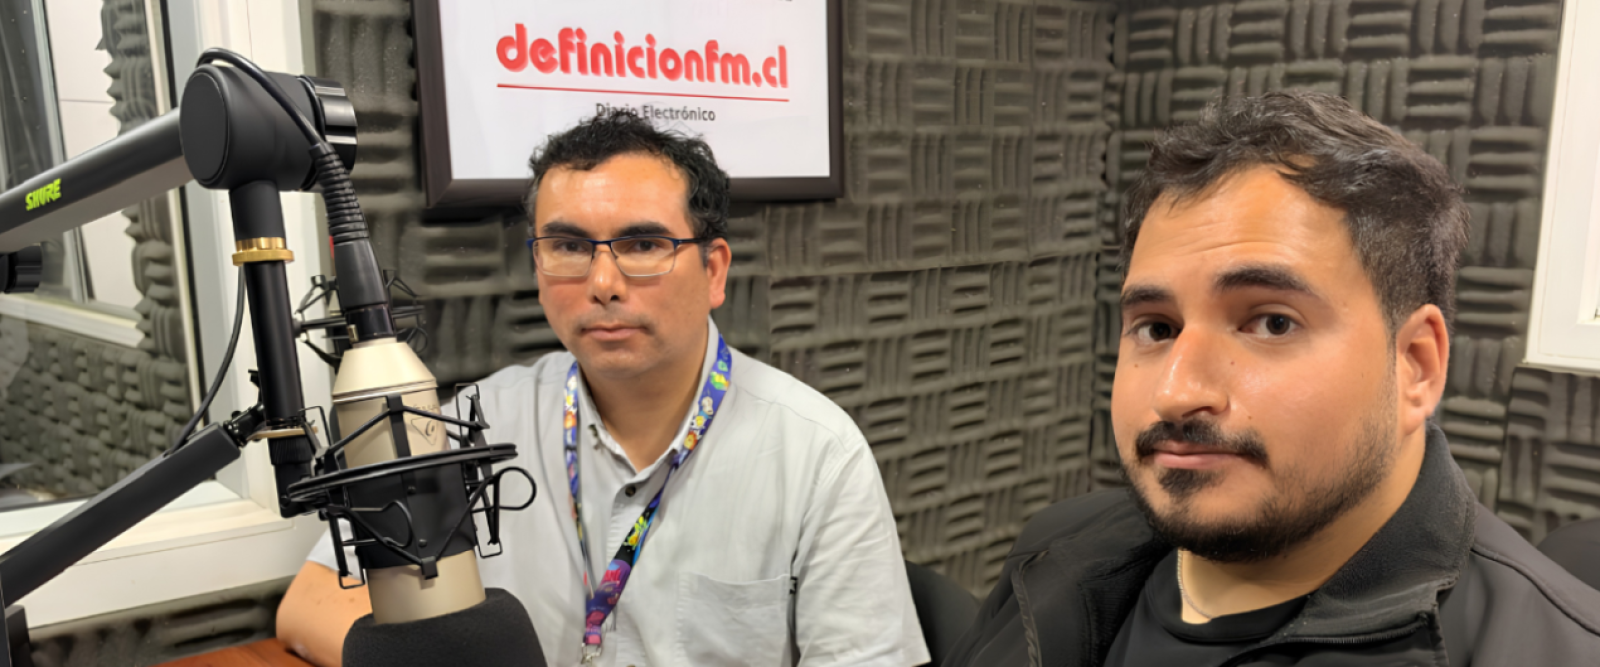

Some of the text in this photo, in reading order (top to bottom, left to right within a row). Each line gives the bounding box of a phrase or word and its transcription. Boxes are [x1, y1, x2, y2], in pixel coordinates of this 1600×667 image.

[496, 23, 789, 88] definicionfm.cl
[643, 104, 716, 121] Electrónico
[25, 178, 61, 211] SHURE
